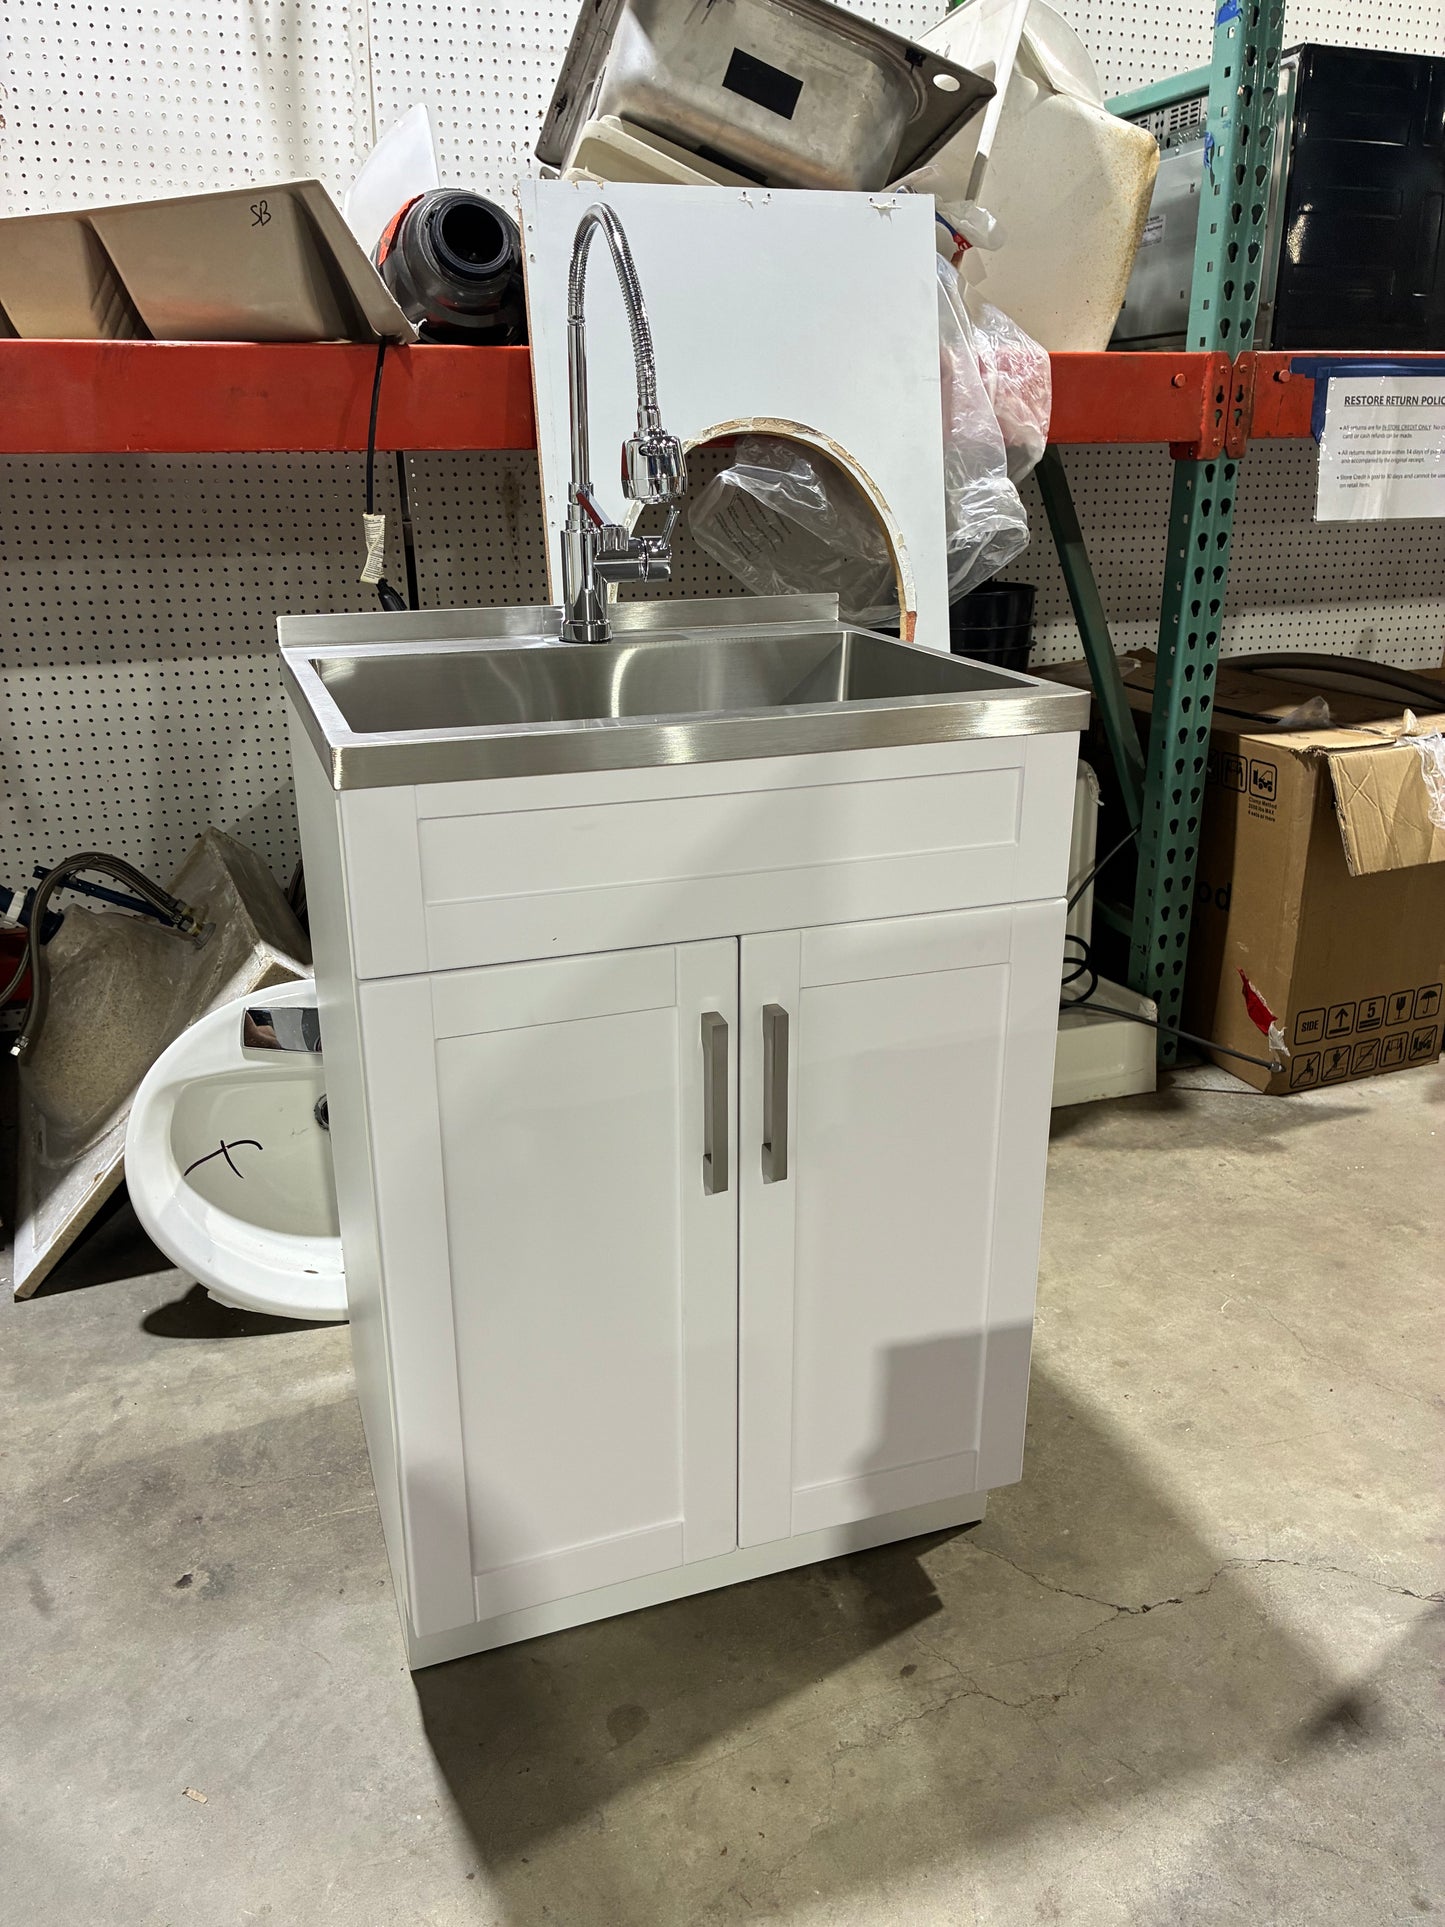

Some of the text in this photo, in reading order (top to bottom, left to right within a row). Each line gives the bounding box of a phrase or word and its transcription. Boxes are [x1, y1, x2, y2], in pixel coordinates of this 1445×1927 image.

[1344, 395, 1384, 406] RESTORE
[1386, 395, 1419, 406] RETURN
[1367, 1001, 1377, 1018] 5
[1301, 1020, 1319, 1032] SIDE
